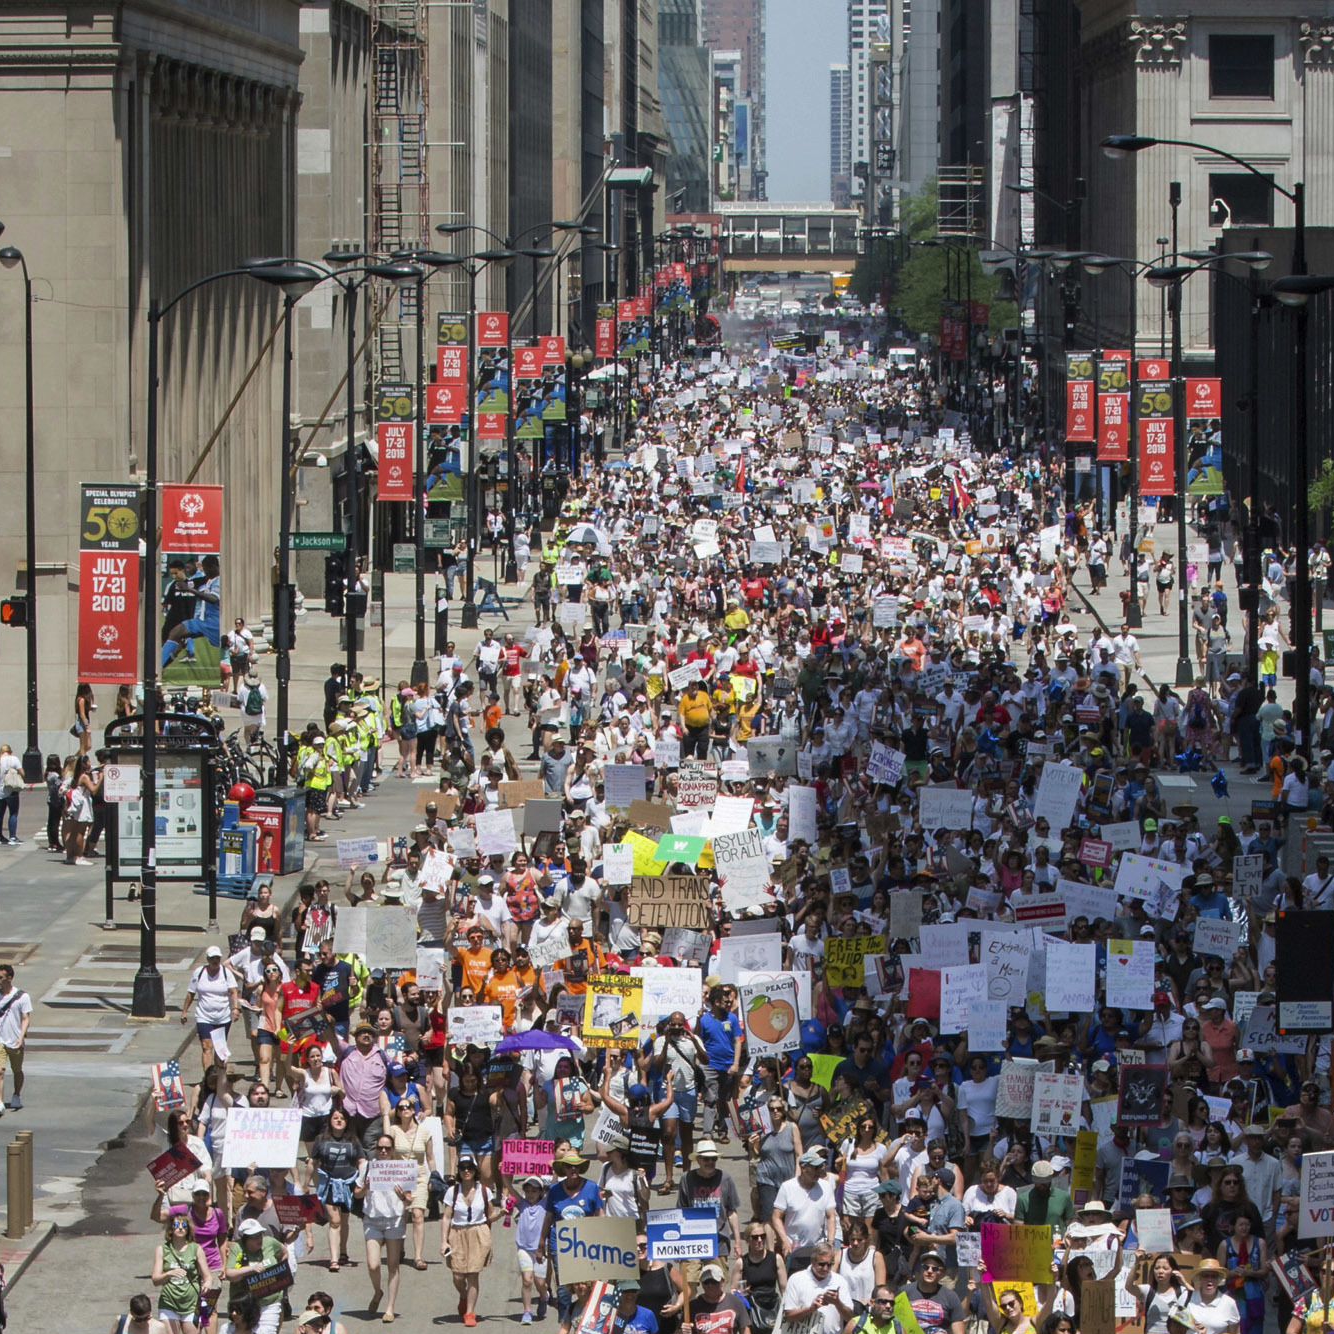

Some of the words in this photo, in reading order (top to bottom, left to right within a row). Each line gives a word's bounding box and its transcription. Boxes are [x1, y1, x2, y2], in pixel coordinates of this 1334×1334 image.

[1147, 423, 1166, 432] JULY
[1147, 434, 1166, 442] 17-21
[1147, 444, 1166, 453] 2018
[86, 490, 108, 498] SPECIAL
[110, 490, 136, 498] OLYMPICS
[300, 536, 331, 546] Jackson
[92, 559, 127, 575] JULY
[92, 577, 126, 593] 17-21
[92, 596, 125, 612] 2018
[1236, 856, 1261, 866] LET
[1236, 868, 1262, 882] LOVE
[631, 878, 664, 898] END
[669, 878, 710, 900] TRANS
[1238, 885, 1259, 896] IN
[628, 902, 707, 927] DETENTION
[744, 989, 753, 997] IN
[766, 982, 794, 993] PEACH
[751, 1046, 768, 1055] DAT
[783, 1040, 799, 1049] ASS
[558, 1226, 637, 1268] Shame
[657, 1244, 709, 1255] MONSTERS
